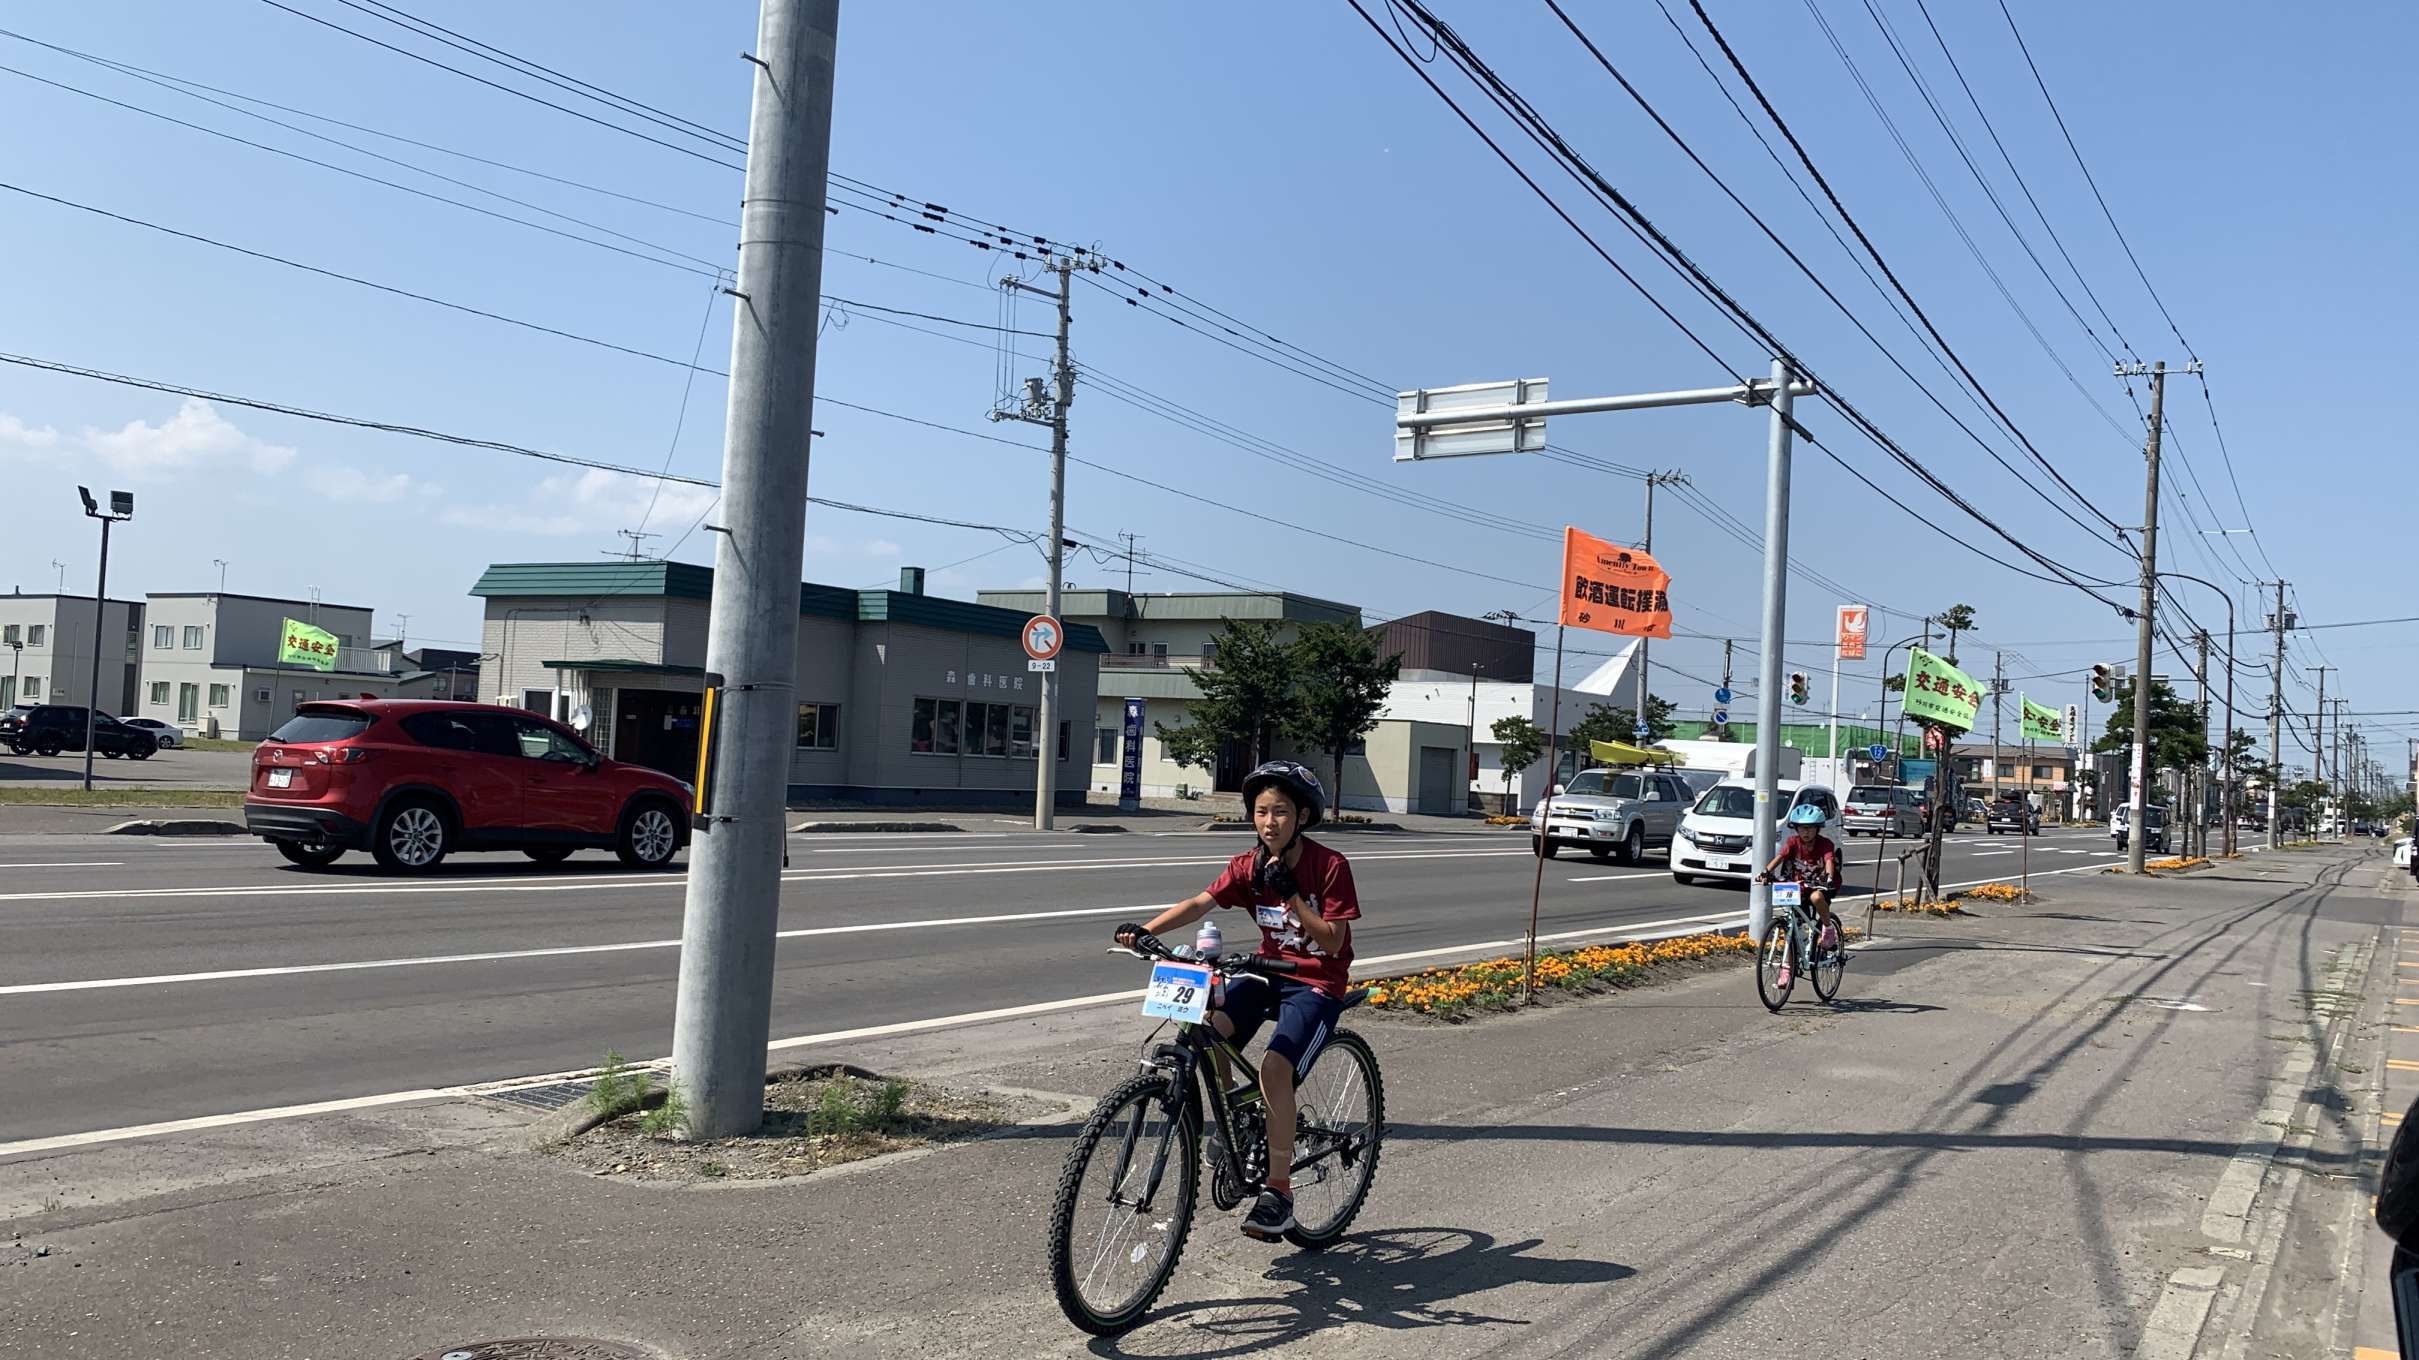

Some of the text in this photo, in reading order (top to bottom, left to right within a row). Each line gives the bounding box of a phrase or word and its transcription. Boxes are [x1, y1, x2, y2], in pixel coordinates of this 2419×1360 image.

[288, 634, 335, 656] 交通安全
[1031, 662, 1051, 670] 9-22
[945, 670, 1024, 690] 森歯科医院
[1914, 670, 1980, 708] 交通安全
[1172, 986, 1195, 1004] 29
